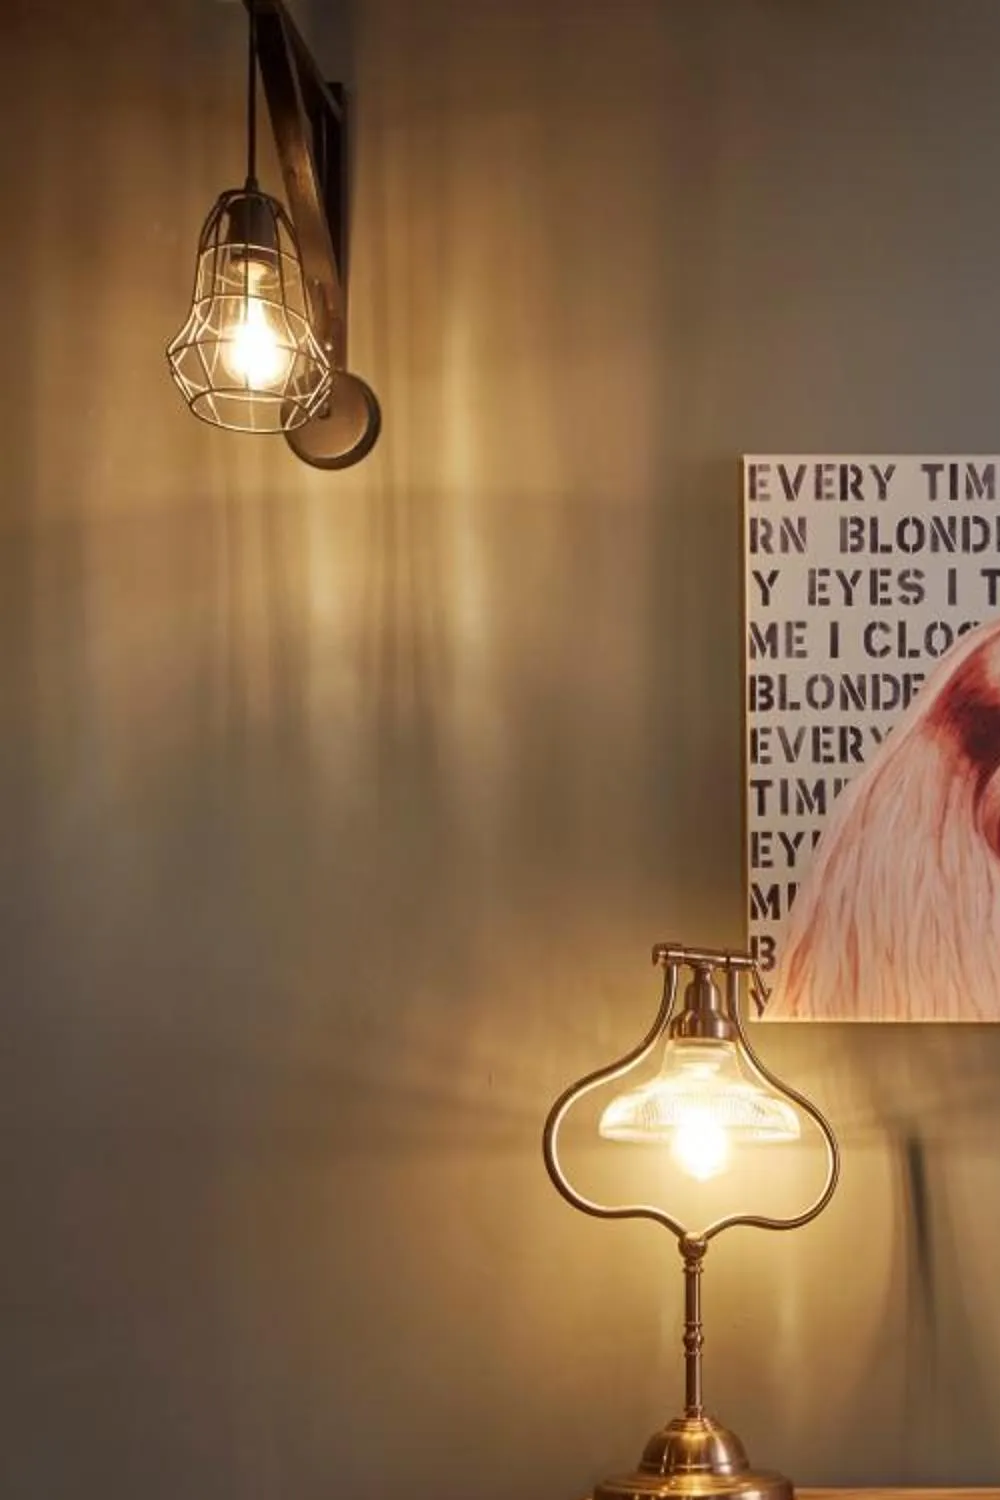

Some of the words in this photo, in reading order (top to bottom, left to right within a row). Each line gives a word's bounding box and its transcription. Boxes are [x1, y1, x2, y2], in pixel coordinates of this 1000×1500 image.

[748, 463, 897, 501] EVERY
[749, 516, 808, 555] RN
[751, 568, 780, 607] Y
[806, 568, 926, 606] EYES
[947, 568, 957, 606] I
[749, 621, 807, 659] ME
[829, 621, 839, 659] I
[863, 620, 980, 659] CLO
[750, 778, 851, 816] TIM
[750, 830, 821, 868] EY
[750, 882, 798, 920] M
